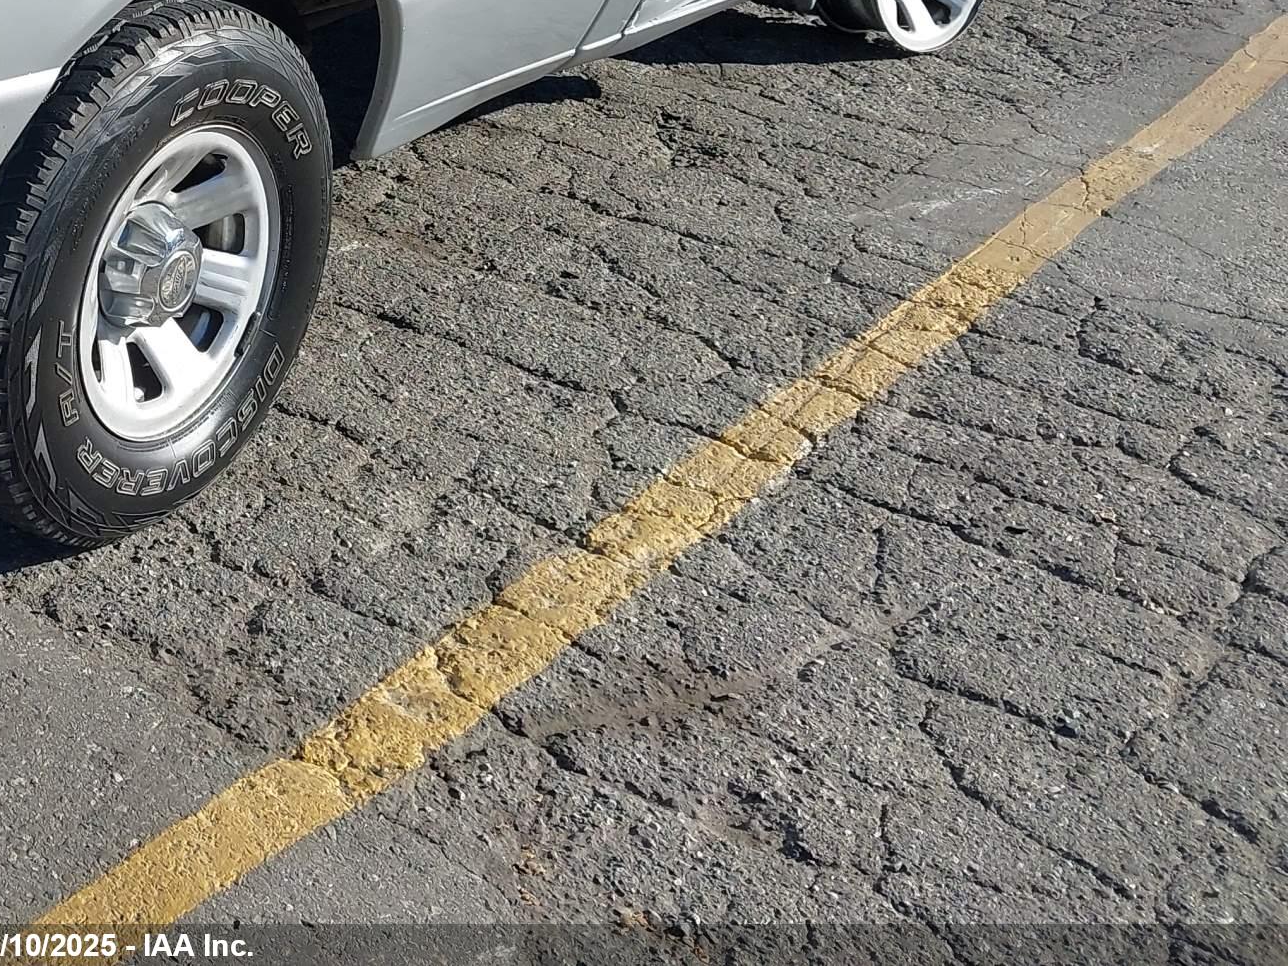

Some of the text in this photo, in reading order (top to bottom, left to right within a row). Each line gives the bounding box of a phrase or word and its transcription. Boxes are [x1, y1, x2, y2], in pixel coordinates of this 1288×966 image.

[170, 79, 312, 159] COOPER
[54, 320, 286, 497] DISCOVERER A/T
